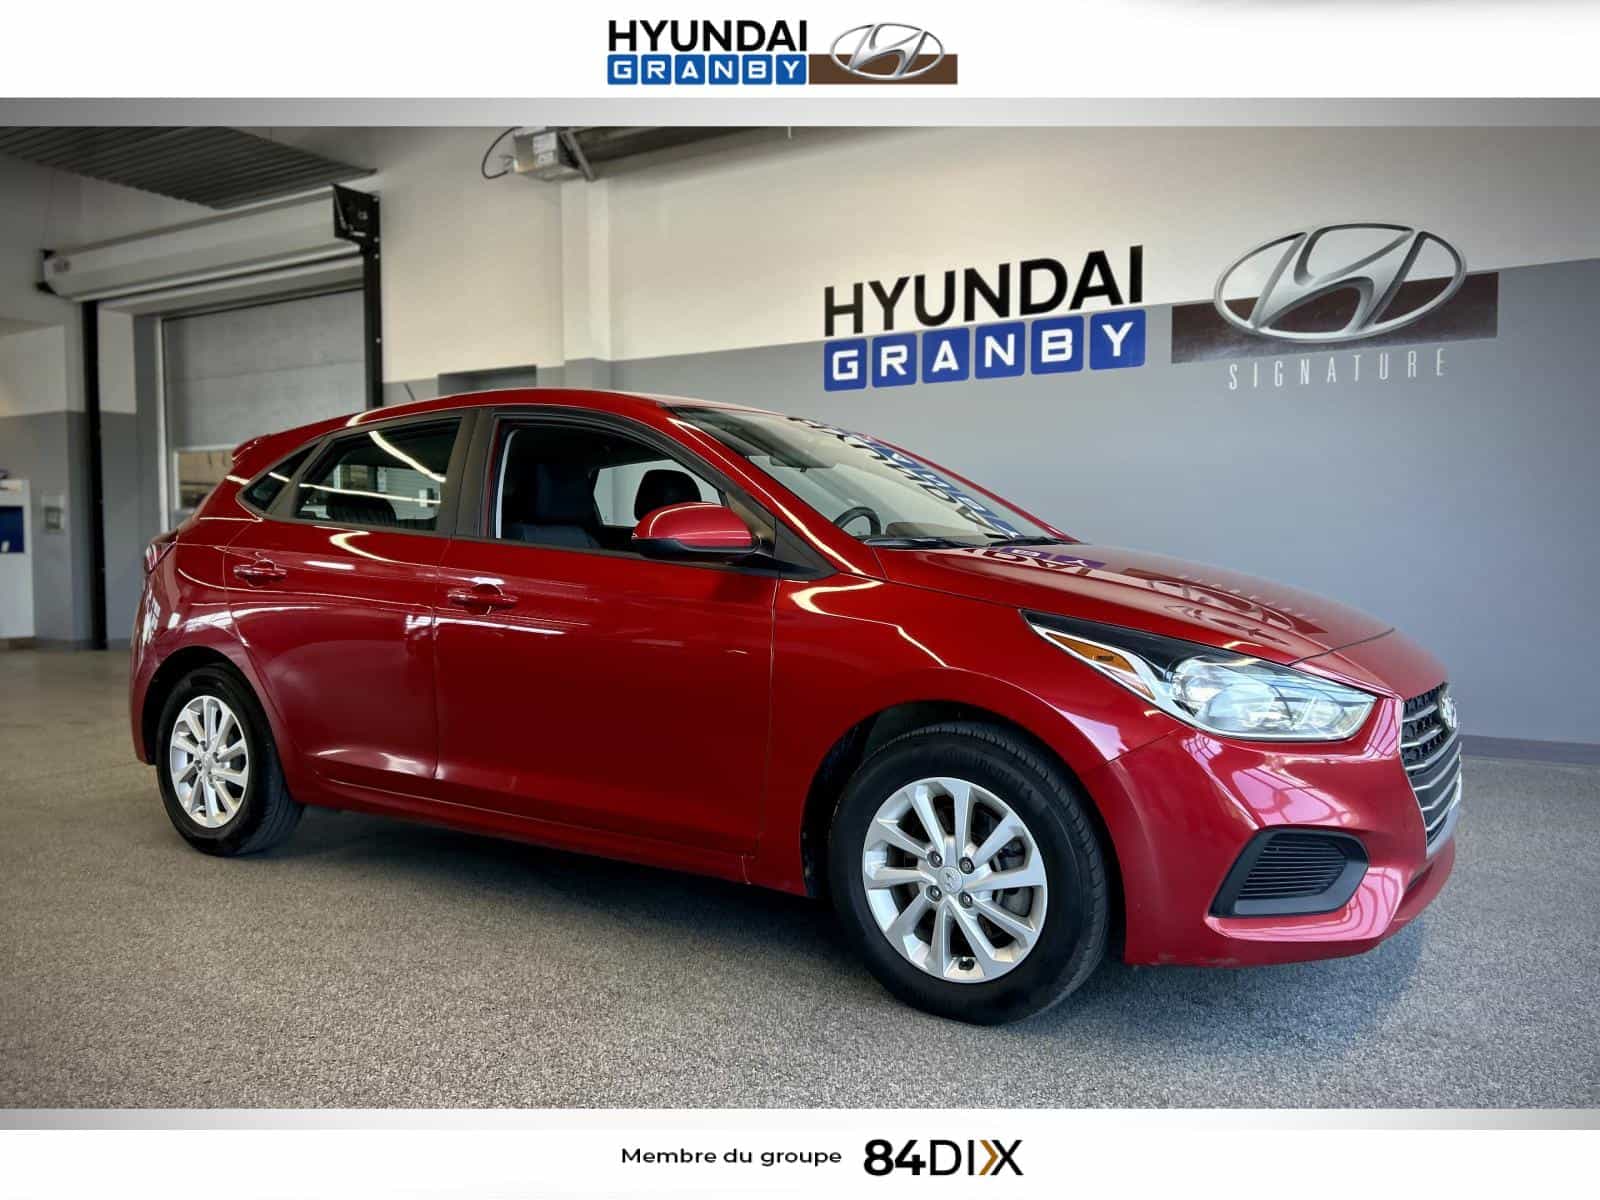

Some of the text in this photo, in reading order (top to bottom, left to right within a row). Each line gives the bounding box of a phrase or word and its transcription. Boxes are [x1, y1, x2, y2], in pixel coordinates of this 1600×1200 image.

[825, 246, 1143, 337] HYUNDAI
[831, 322, 1135, 383] GRANBY
[1228, 348, 1448, 391] SIGNATURE
